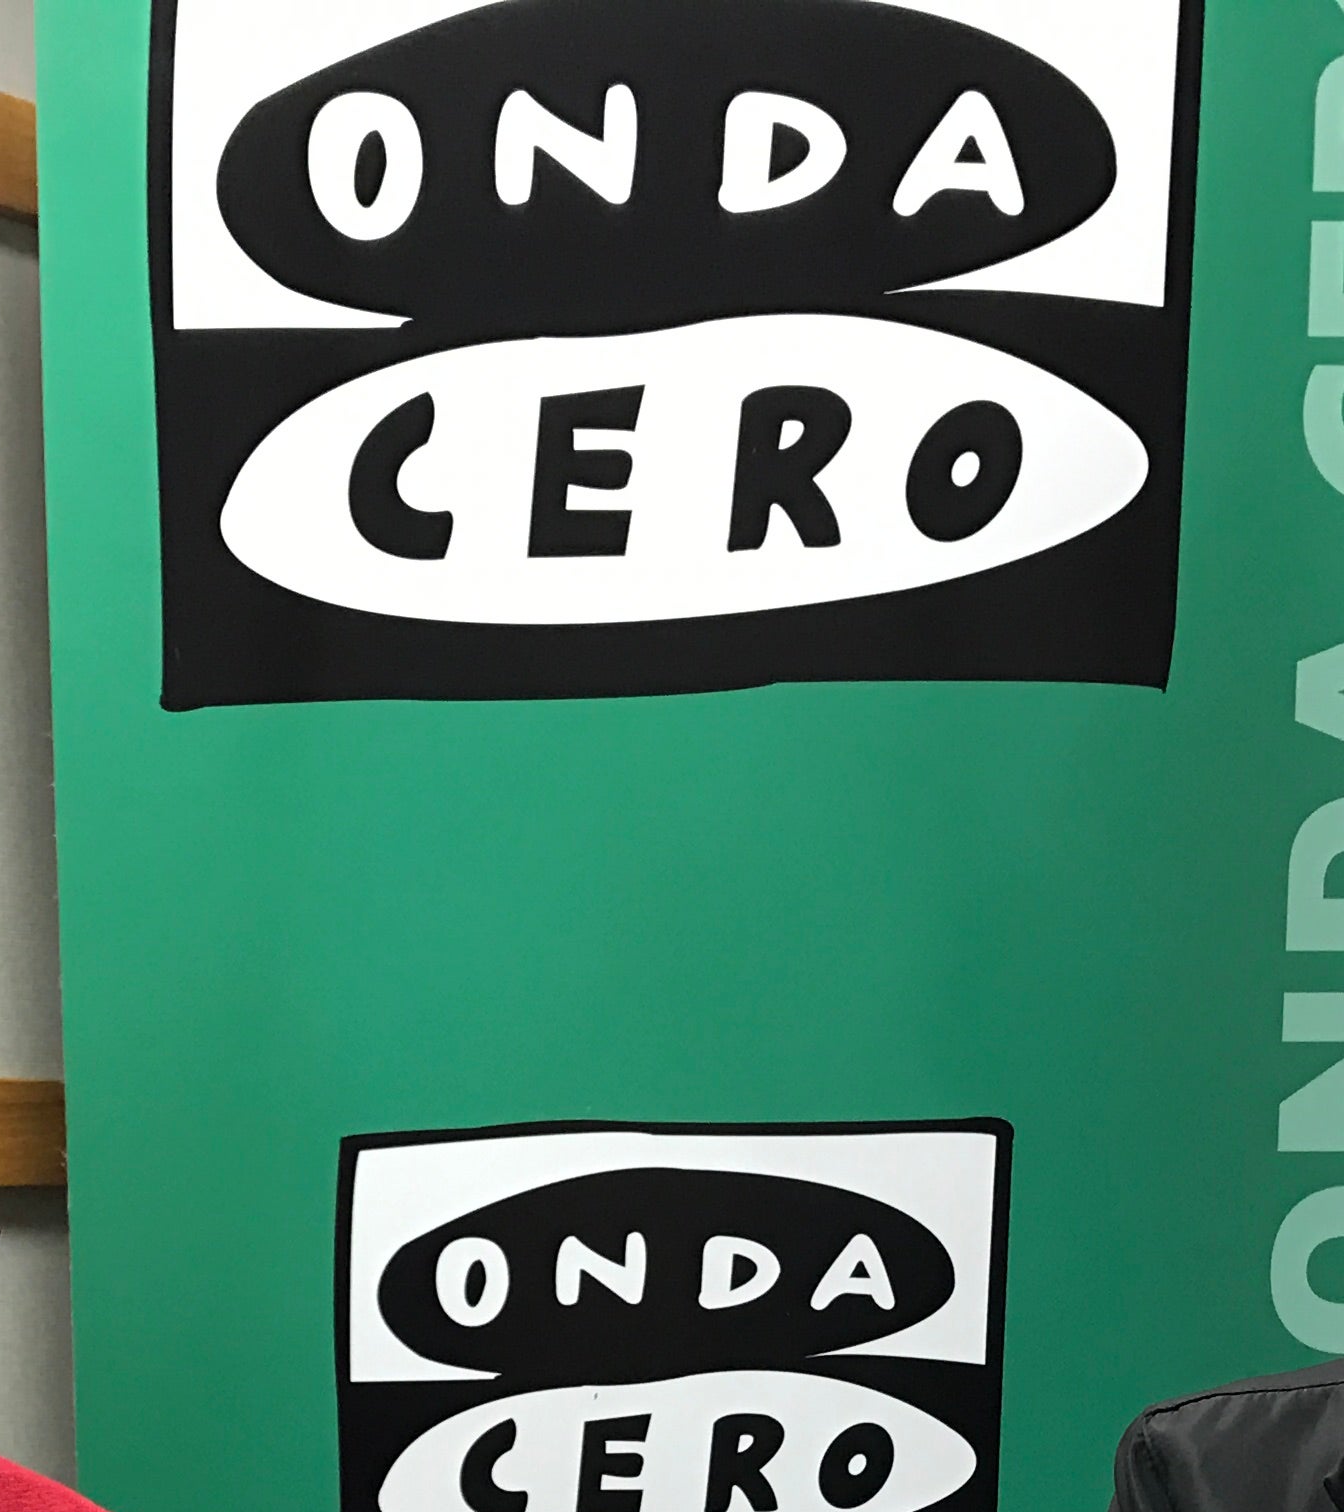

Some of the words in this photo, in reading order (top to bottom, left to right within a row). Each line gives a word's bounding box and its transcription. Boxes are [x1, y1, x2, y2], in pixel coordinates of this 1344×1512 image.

[307, 82, 1026, 242] ONDA
[347, 382, 1025, 560] CERO
[434, 1231, 896, 1328] ONDA
